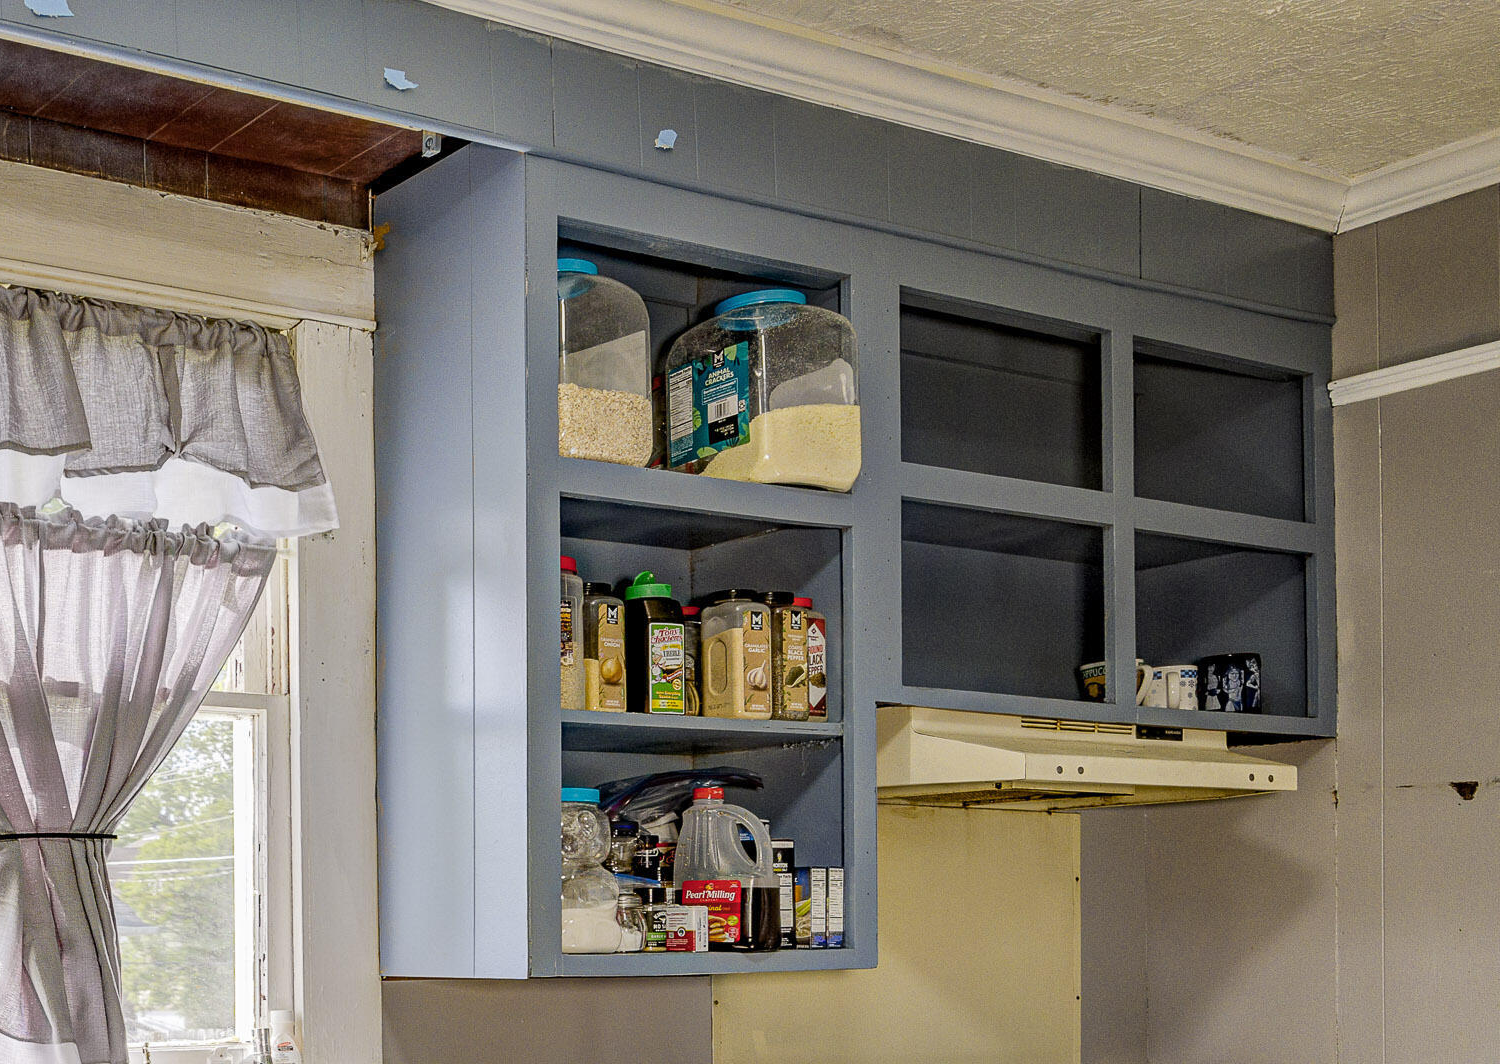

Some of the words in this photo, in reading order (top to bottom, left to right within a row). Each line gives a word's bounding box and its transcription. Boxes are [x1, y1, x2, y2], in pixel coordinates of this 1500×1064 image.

[704, 371, 734, 386] CRACKERS
[708, 367, 731, 379] ANIMAL
[686, 890, 706, 899] Pearl
[706, 890, 736, 902] Milling
